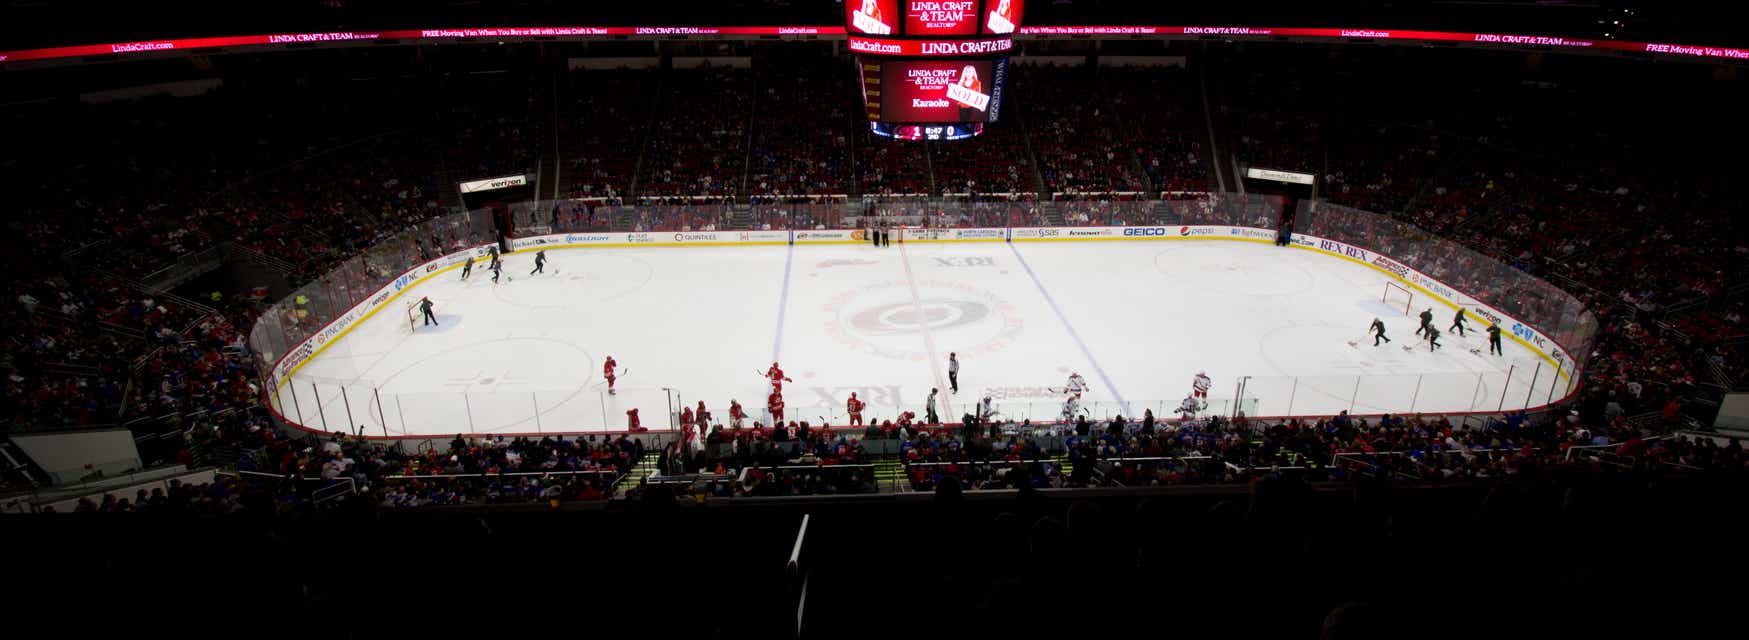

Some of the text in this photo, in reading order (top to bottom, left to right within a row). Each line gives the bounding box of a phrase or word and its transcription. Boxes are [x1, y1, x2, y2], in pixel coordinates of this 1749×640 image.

[911, 1, 973, 11] LINDA CRAFT
[929, 11, 963, 21] TEAM
[269, 35, 296, 43] LINDA
[1475, 34, 1501, 42] LINDA
[112, 42, 174, 53] LindaCraft.com
[850, 39, 902, 53] LindaCraft.com
[922, 42, 958, 54] LINDA
[1646, 43, 1670, 52] FREE
[1670, 45, 1703, 56] Moving
[1705, 48, 1722, 56] Van
[908, 69, 957, 77] LINDA CRAFT
[922, 77, 949, 85] TEAM
[912, 98, 950, 108] Karaoke
[490, 178, 521, 189] verizon
[1123, 227, 1165, 236] GEICO
[1191, 227, 1215, 236] pepsi
[1320, 240, 1344, 254] REX
[1345, 246, 1368, 261] REX
[408, 271, 418, 281] NC
[1475, 307, 1501, 323] verizon
[1533, 335, 1546, 349] NC
